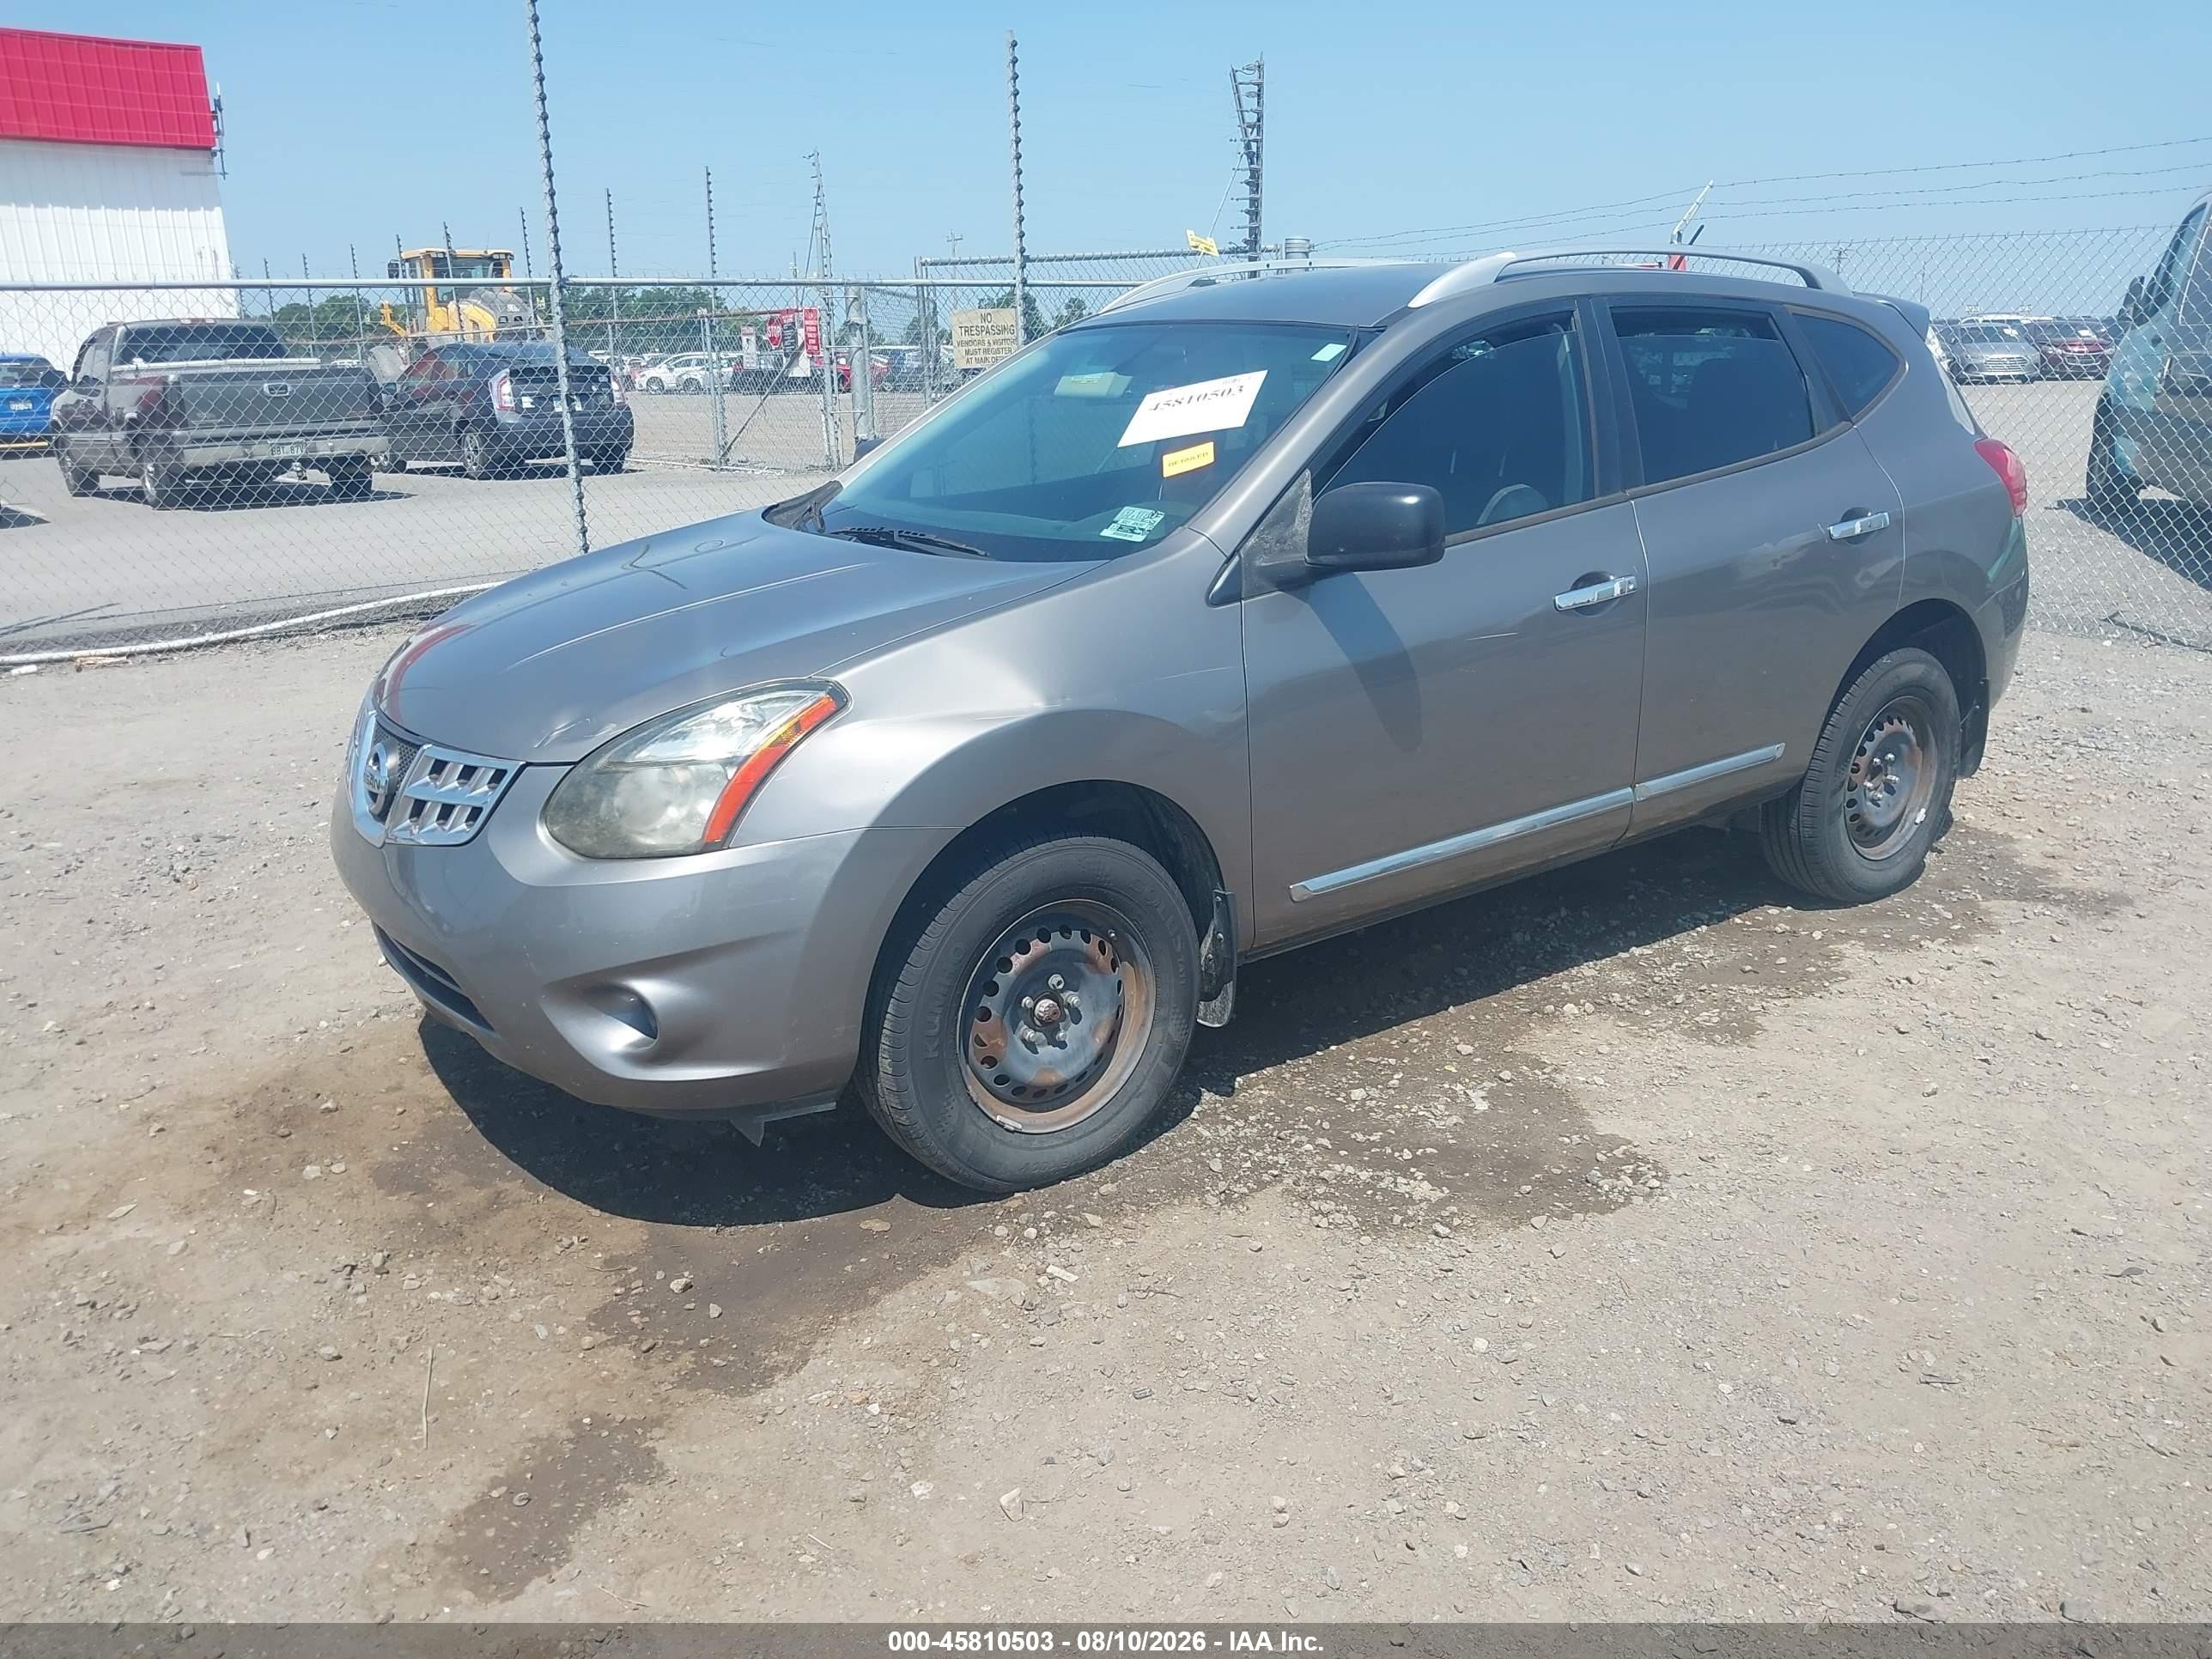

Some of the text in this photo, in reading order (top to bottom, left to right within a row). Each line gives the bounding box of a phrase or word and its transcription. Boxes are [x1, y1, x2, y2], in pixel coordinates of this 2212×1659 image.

[981, 313, 992, 324] NO
[768, 325, 781, 337] STOP
[958, 324, 1015, 337] TRESPASSING
[965, 347, 1012, 356] MUST REGISTER
[1148, 385, 1244, 411] 45810503
[1168, 452, 1209, 467] DETAILED
